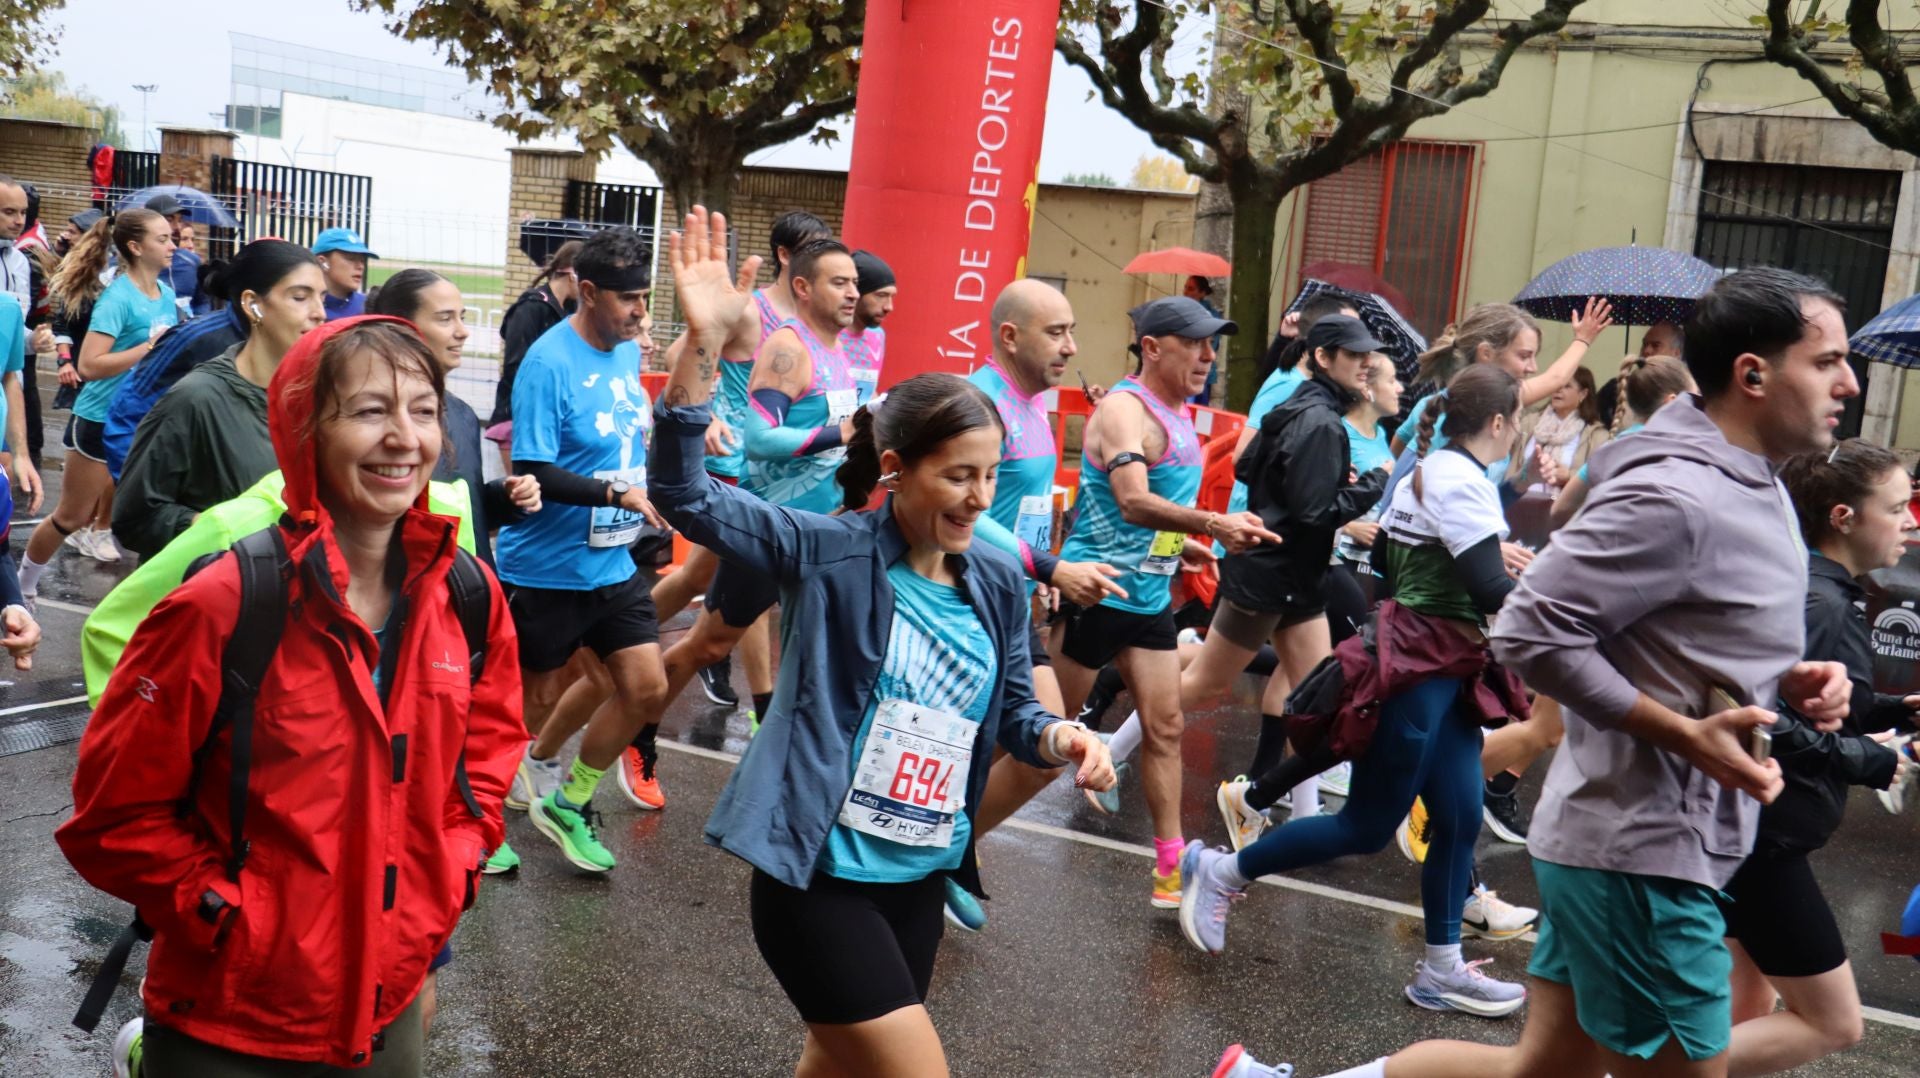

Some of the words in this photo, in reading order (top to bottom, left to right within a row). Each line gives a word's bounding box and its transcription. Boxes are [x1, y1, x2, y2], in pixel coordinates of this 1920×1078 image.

[964, 17, 1023, 231] DEPORTES
[954, 249, 990, 302] DE
[1871, 629, 1903, 645] Cuna
[888, 751, 955, 810] 694
